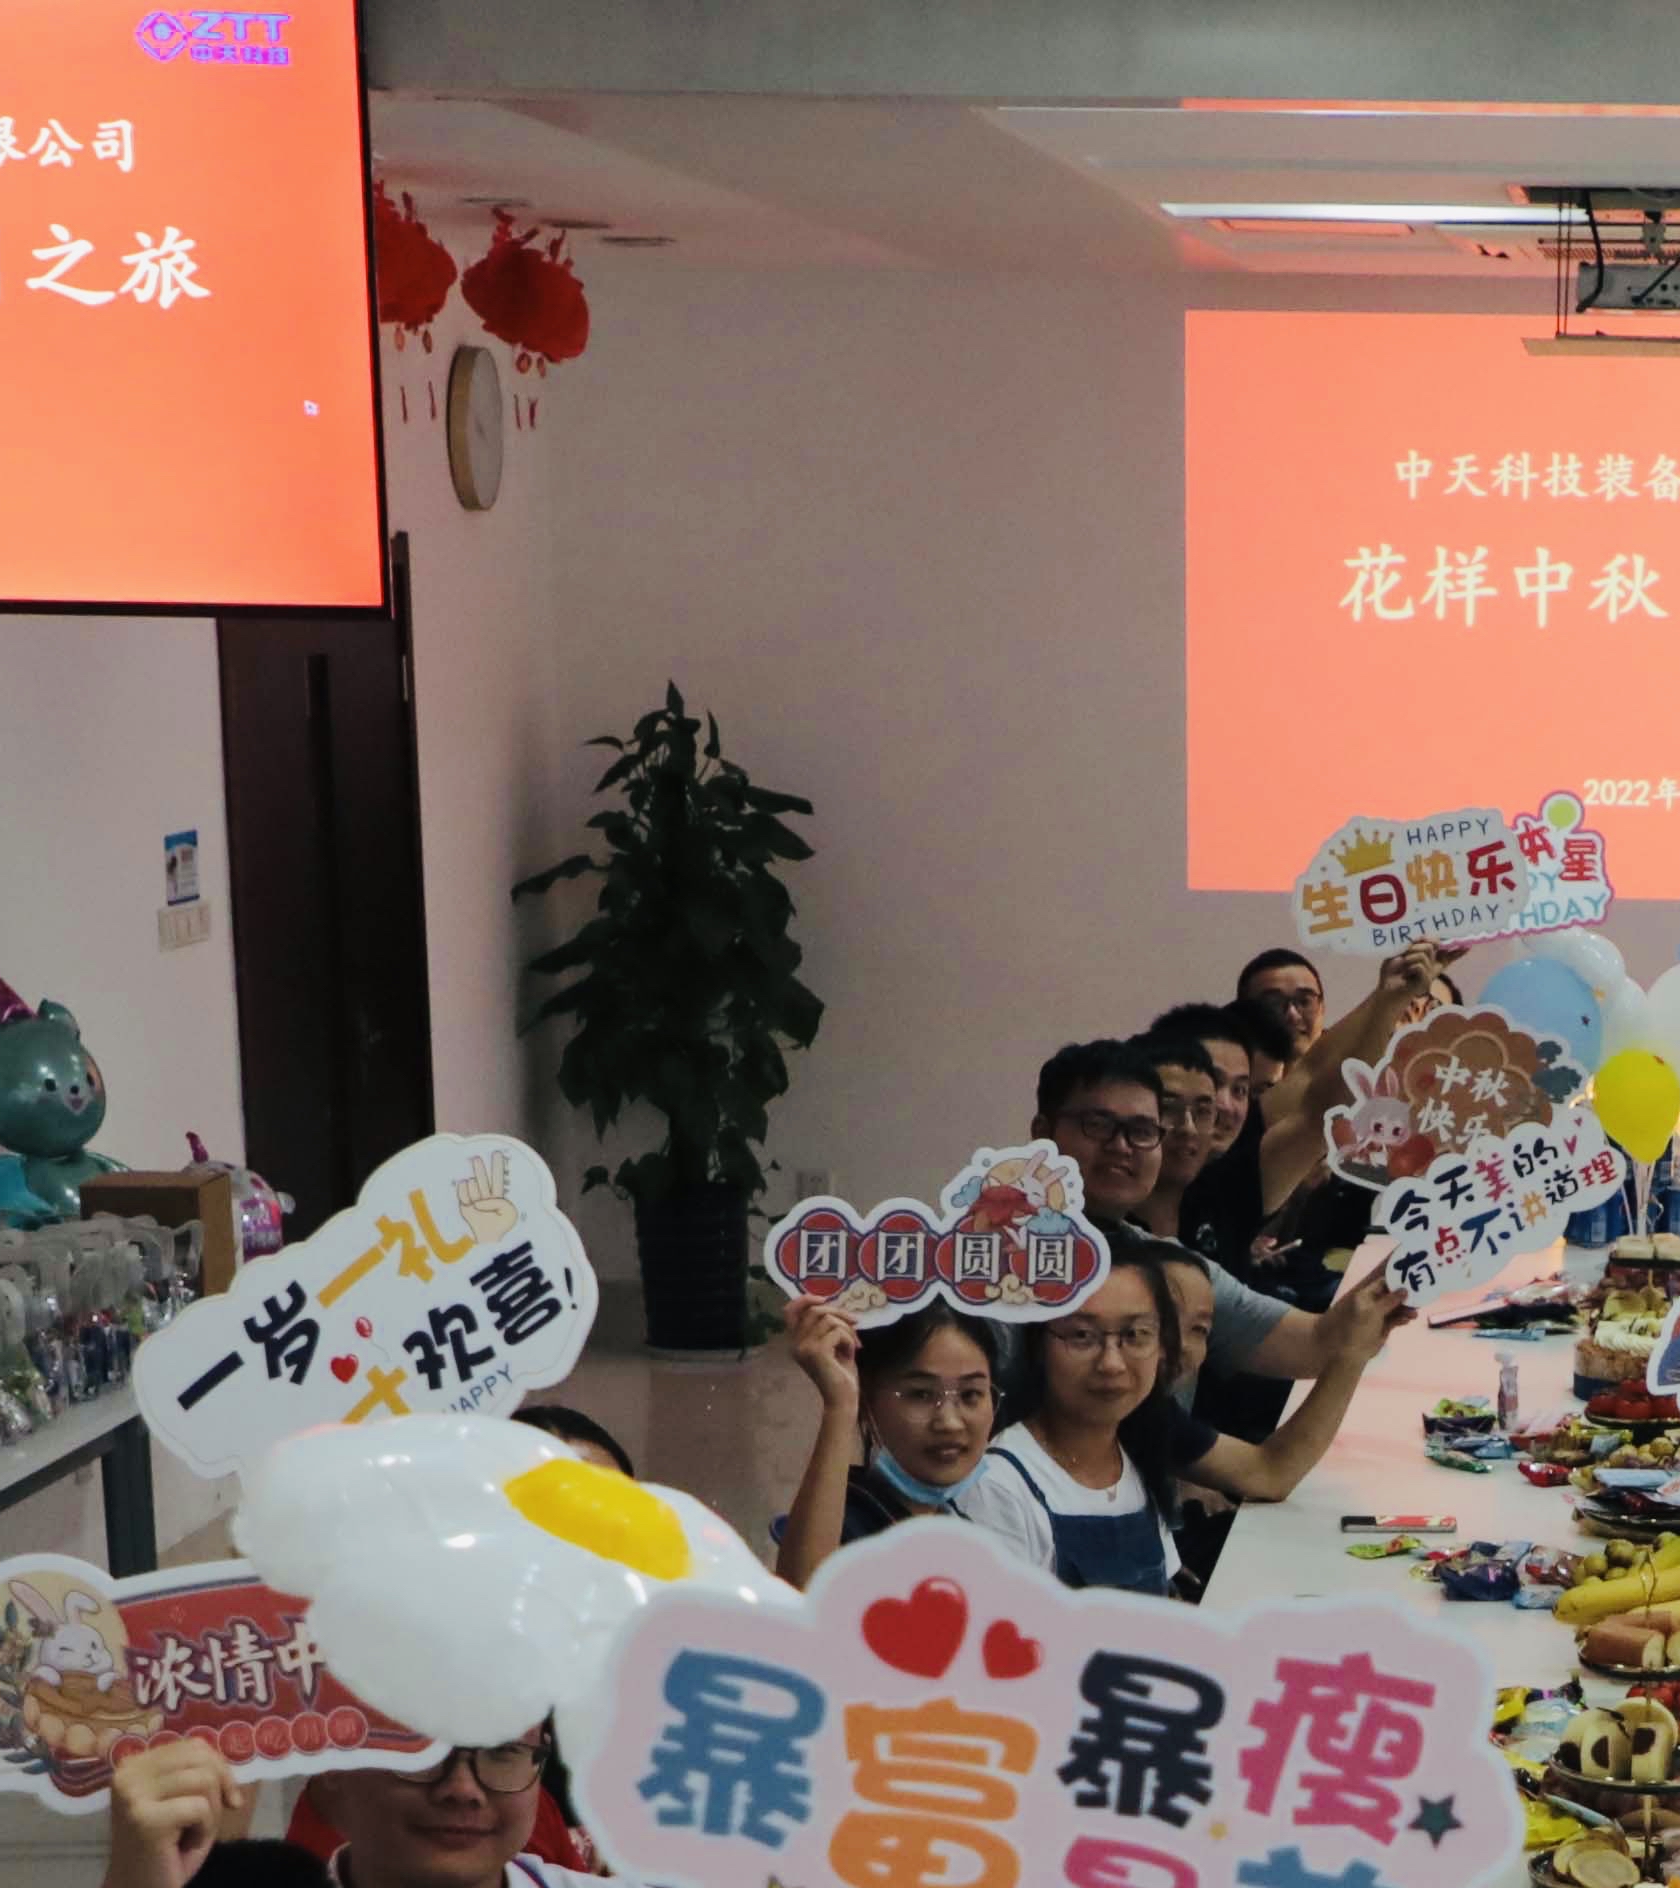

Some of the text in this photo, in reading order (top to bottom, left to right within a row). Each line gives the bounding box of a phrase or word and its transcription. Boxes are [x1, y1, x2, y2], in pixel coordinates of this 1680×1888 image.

[190, 11, 291, 42] ZTT
[1340, 546, 1669, 630] 花样中秋
[1406, 818, 1489, 845] HAPPY
[1301, 839, 1517, 935] 生日快乐
[1372, 903, 1500, 947] BIRTHDAY
[1434, 1055, 1510, 1108] 中秋
[1417, 1096, 1492, 1145] 快乐
[1389, 1136, 1559, 1232] 今天美的
[1393, 1150, 1619, 1292] 有点不讲道理
[798, 1229, 1074, 1285] 团团圆圆
[177, 1188, 477, 1411] 一岁一礼
